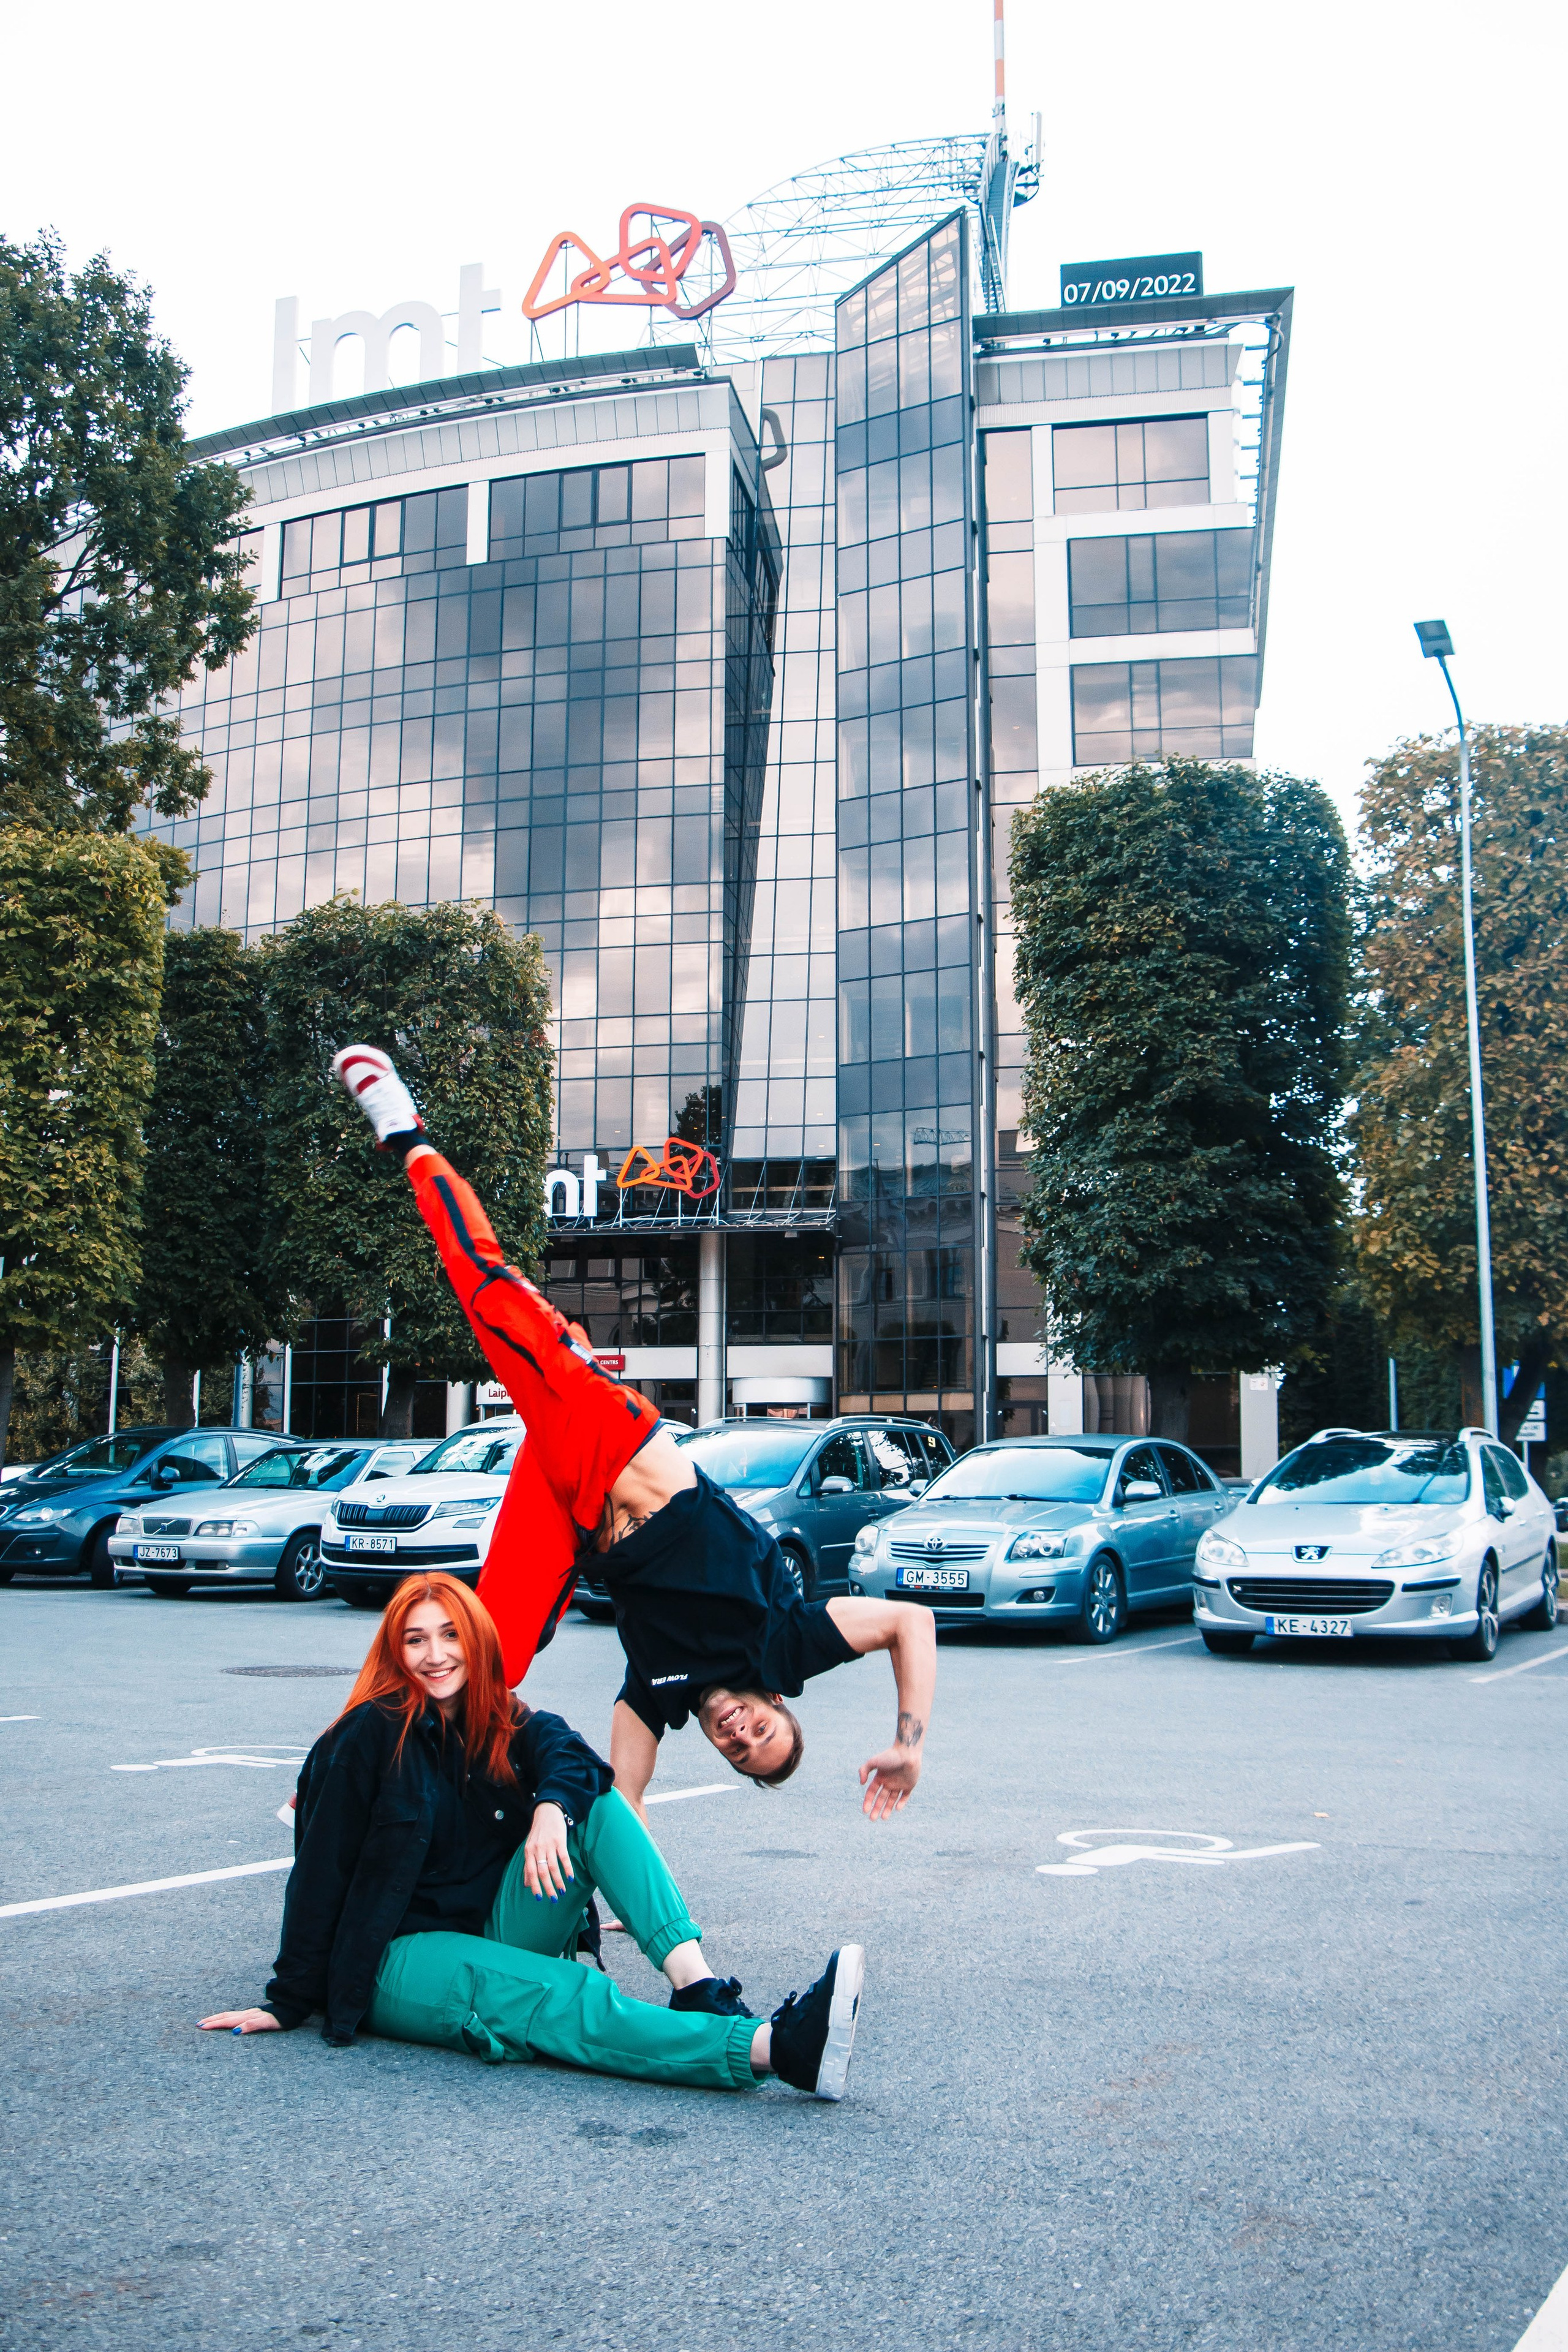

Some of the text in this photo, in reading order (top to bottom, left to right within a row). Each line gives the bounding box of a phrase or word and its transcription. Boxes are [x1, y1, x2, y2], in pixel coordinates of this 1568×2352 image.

[1064, 273, 1196, 304] 07/09/2022
[271, 263, 501, 417] lmt
[928, 1436, 936, 1447] 9
[352, 1538, 393, 1550] KR-8571
[140, 1547, 176, 1558] JZ-7673
[907, 1571, 965, 1585] GM-3555
[1278, 1619, 1348, 1634] KE-4327
[652, 1676, 666, 1686] ERA
